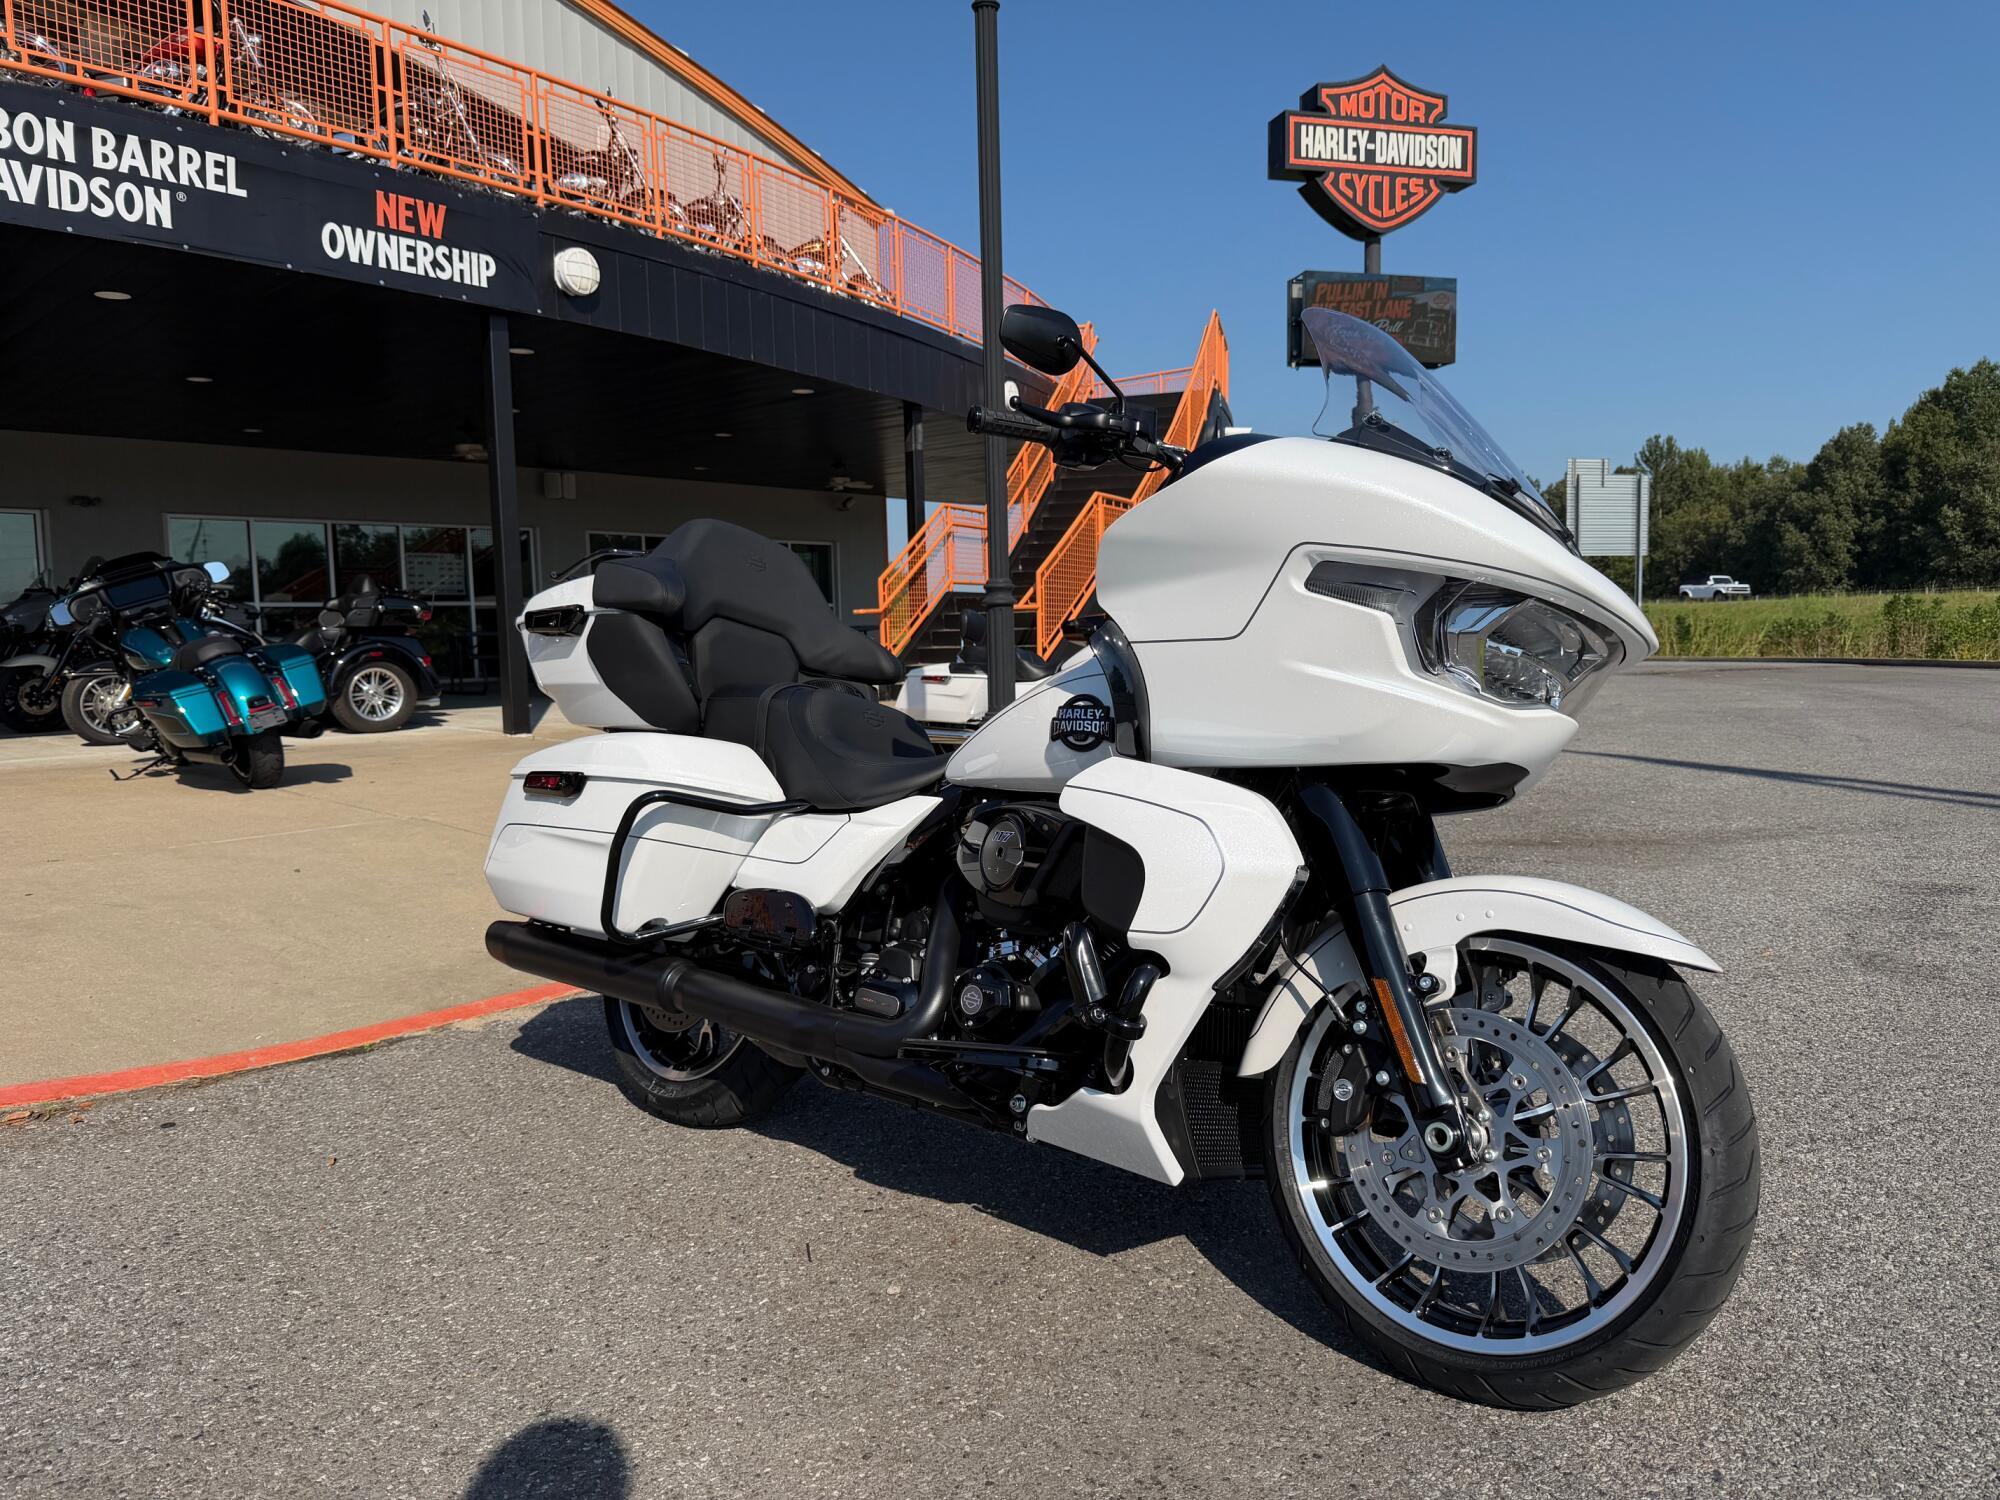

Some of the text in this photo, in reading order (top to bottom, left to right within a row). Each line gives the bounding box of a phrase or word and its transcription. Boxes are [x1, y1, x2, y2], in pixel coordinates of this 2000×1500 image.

[1340, 82, 1426, 123] MOTOR
[91, 126, 248, 198] BARREL
[1300, 124, 1462, 169] HARLEY-DAVIDSON
[376, 189, 447, 240] NEW
[1339, 173, 1425, 218] CYCLES
[321, 221, 497, 289] OWNERSHIP
[1373, 281, 1389, 299] IN
[1375, 299, 1414, 319] LANE
[1053, 720, 1110, 737] DAVIDSON
